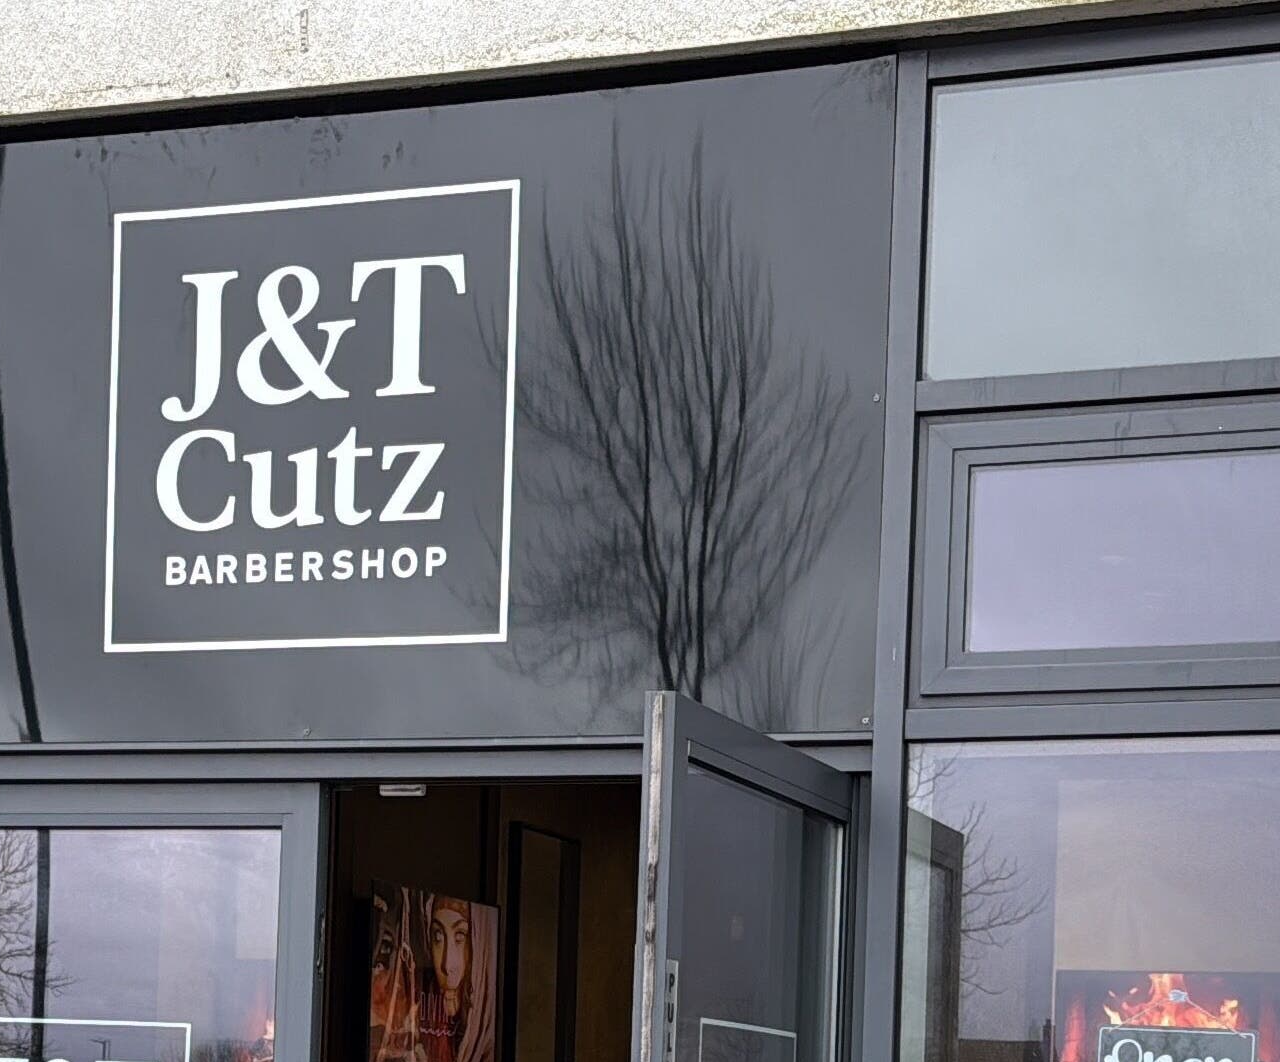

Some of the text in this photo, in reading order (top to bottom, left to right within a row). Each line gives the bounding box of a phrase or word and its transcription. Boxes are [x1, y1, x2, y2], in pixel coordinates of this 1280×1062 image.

[161, 253, 466, 422] J&T
[156, 426, 446, 532] Cutz
[165, 545, 447, 586] BARBERSHOP
